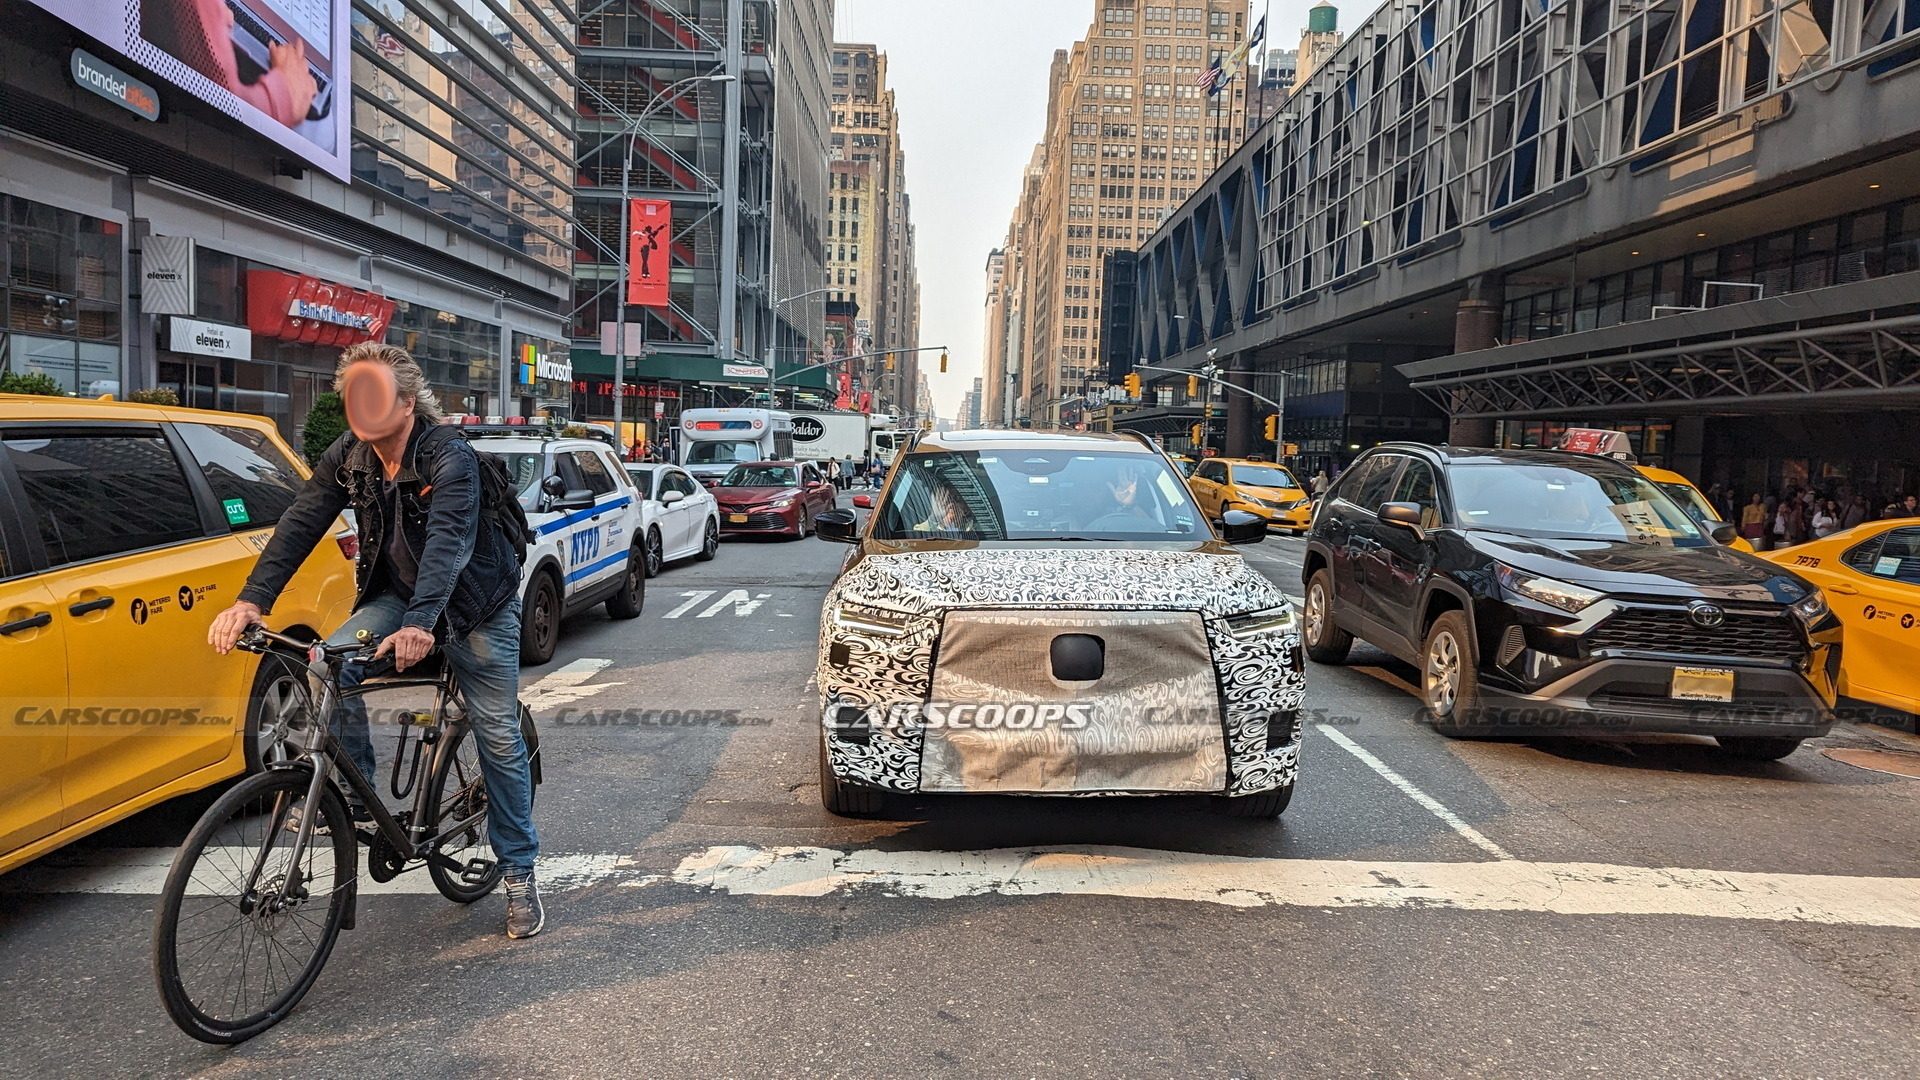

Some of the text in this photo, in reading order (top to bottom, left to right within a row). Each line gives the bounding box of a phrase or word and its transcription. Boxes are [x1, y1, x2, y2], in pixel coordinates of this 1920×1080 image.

[147, 271, 175, 280] eleven
[299, 300, 362, 328] Bank of America
[206, 327, 218, 336] Retail
[195, 333, 224, 348] eleven
[536, 353, 573, 382] Microsoft
[790, 421, 822, 435] Baldor
[226, 503, 245, 515] curb
[570, 526, 600, 566] NYPD
[194, 584, 217, 595] FLAT FARE
[149, 595, 171, 607] METERED
[150, 606, 163, 615] FARE
